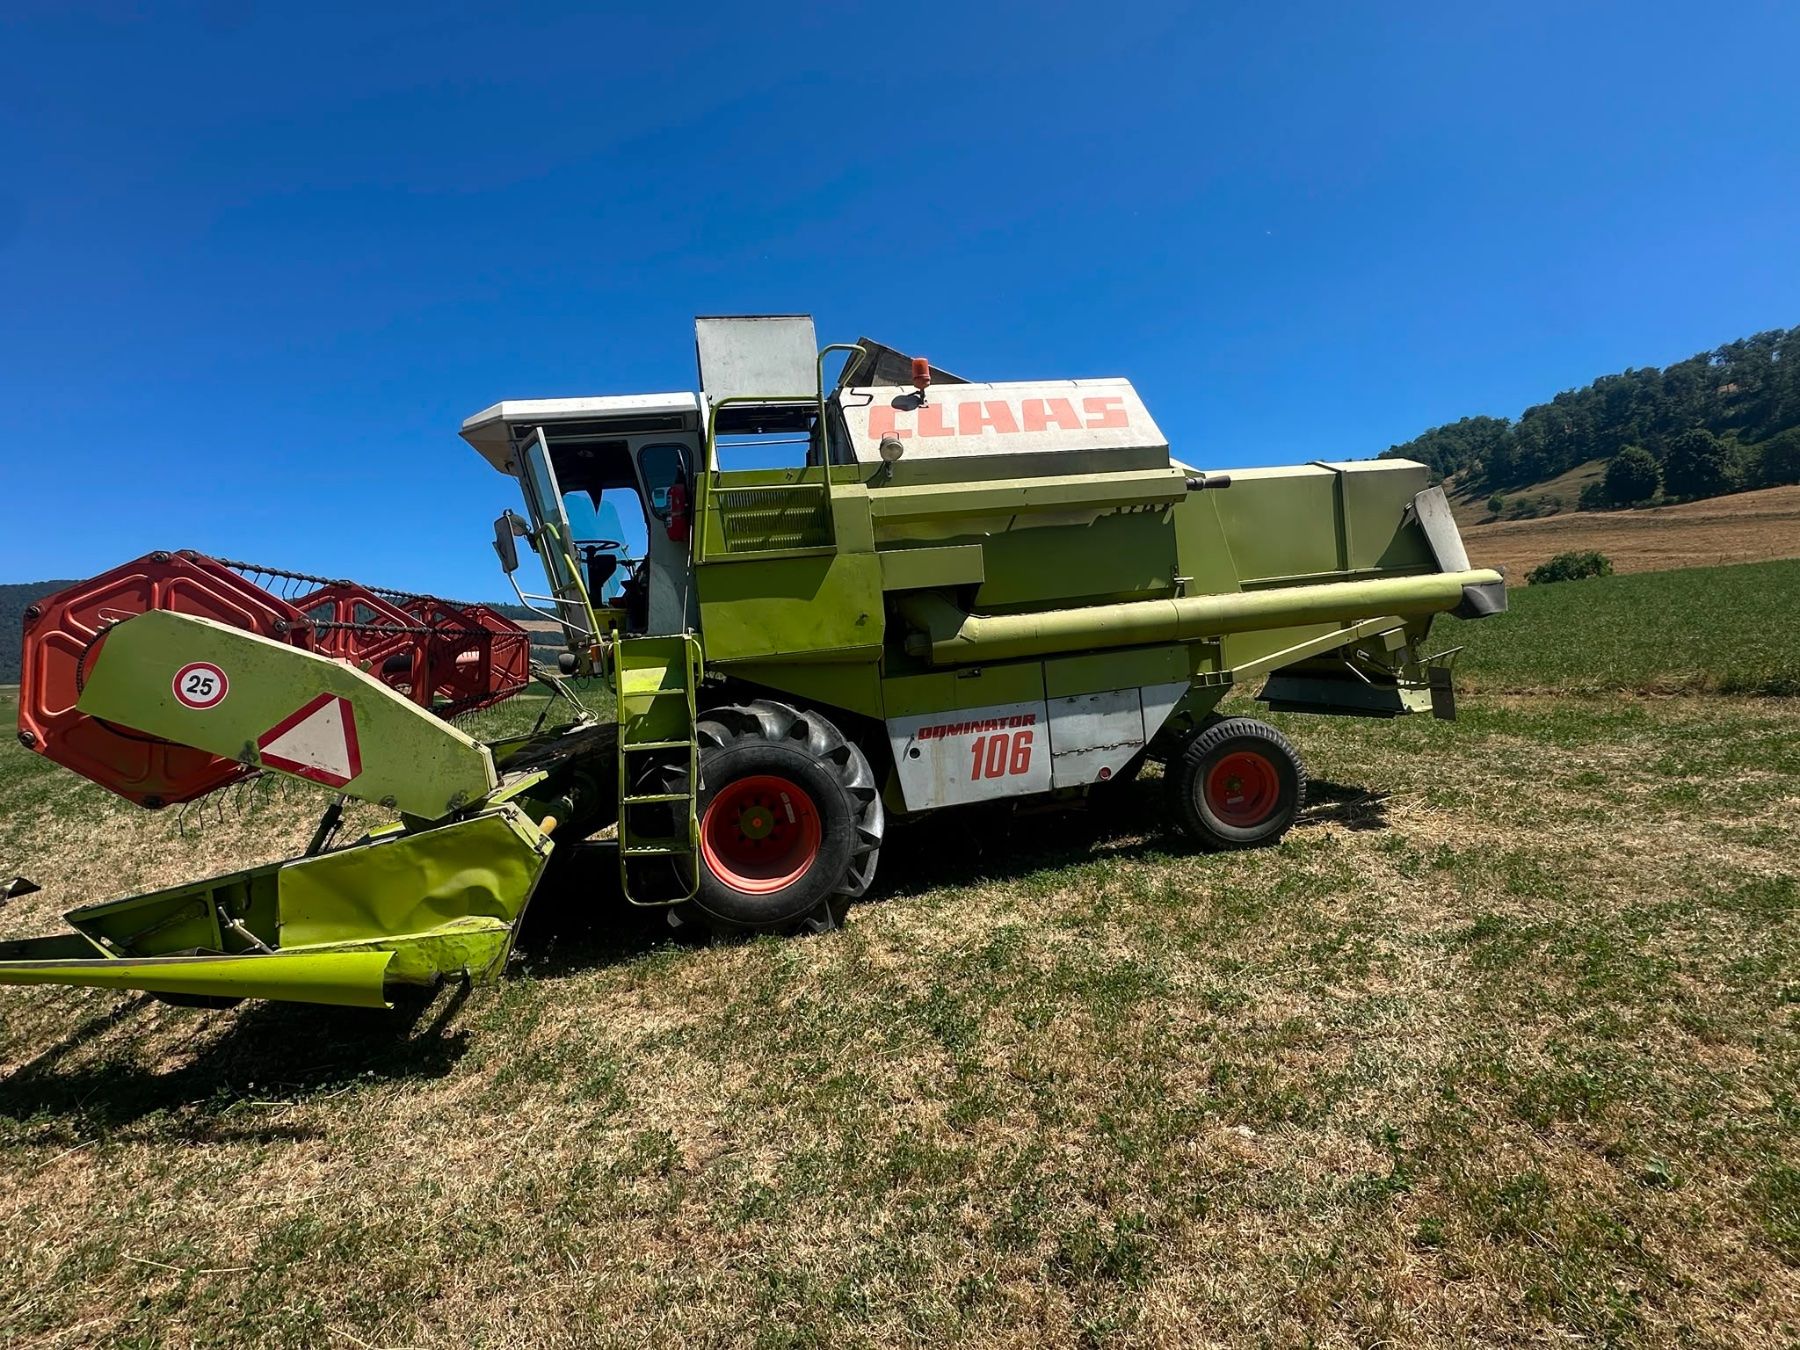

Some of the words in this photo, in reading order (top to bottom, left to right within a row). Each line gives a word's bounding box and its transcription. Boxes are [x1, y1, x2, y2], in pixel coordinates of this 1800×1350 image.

[868, 398, 1129, 439] CLAAS
[187, 676, 214, 696] 25
[918, 714, 1036, 740] DOMINATOR
[971, 731, 1034, 781] 106
